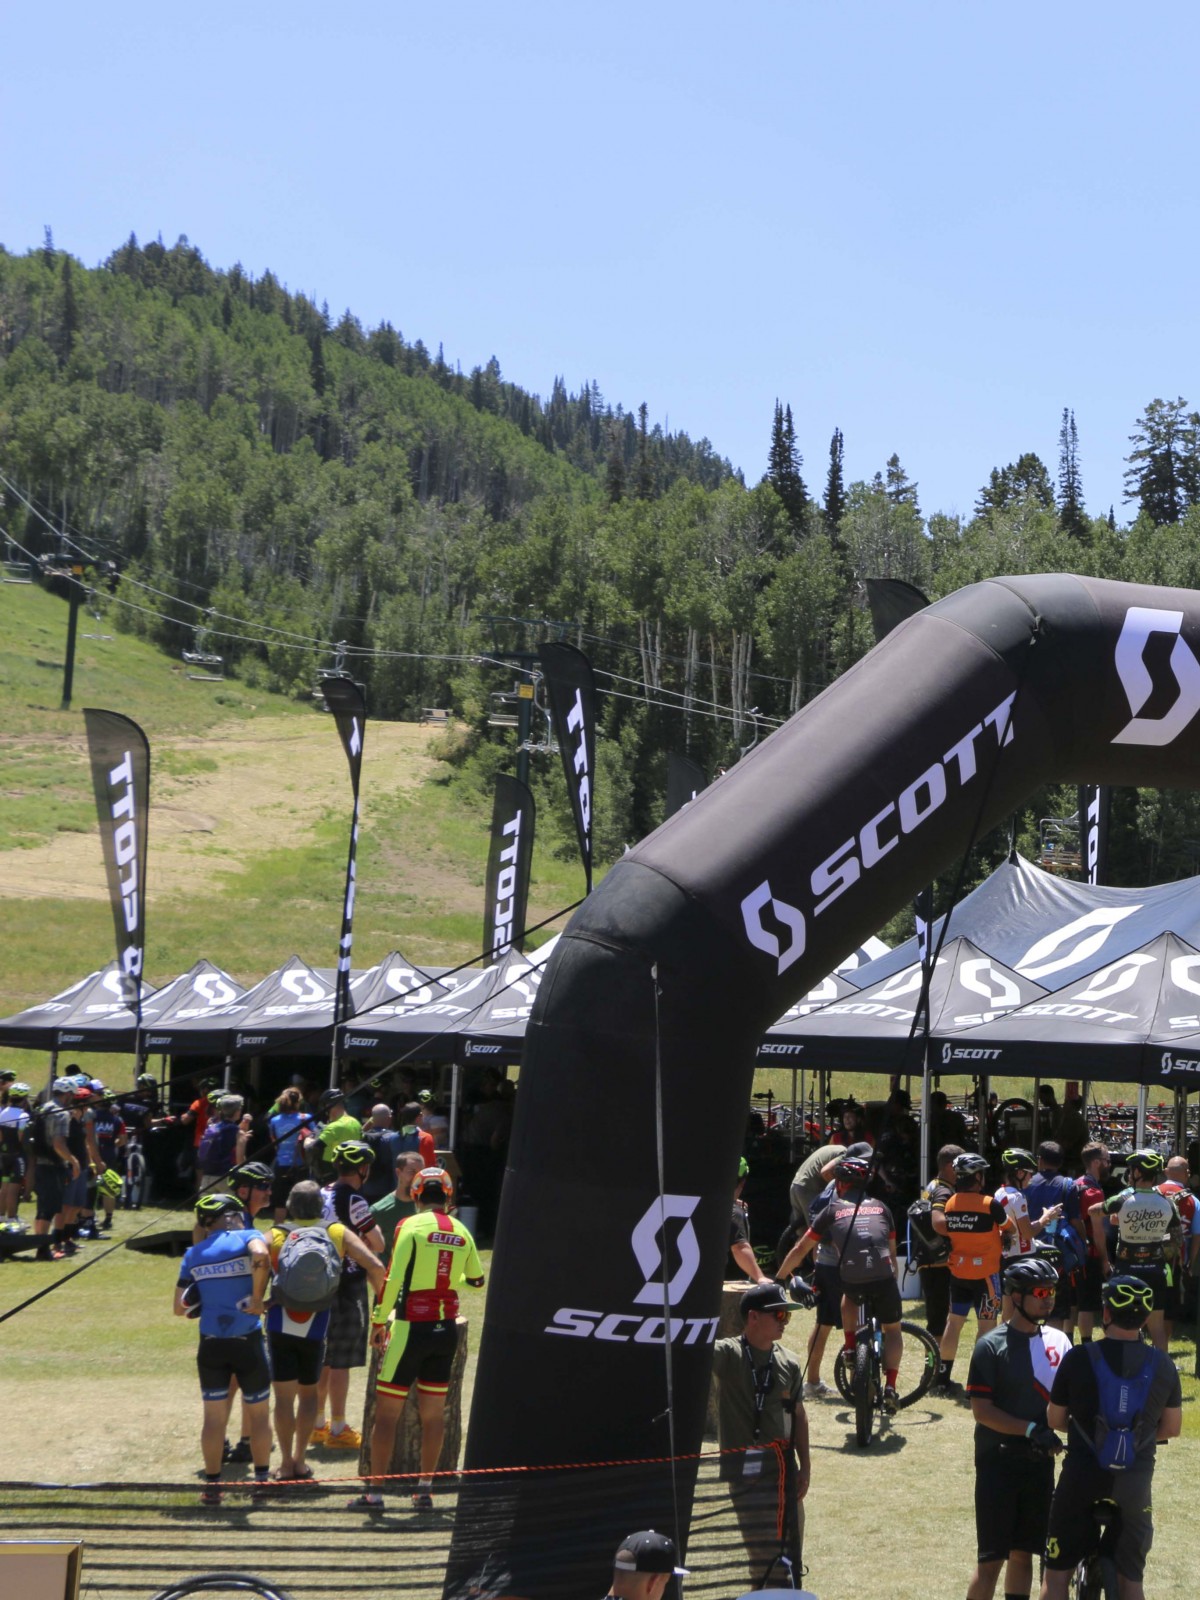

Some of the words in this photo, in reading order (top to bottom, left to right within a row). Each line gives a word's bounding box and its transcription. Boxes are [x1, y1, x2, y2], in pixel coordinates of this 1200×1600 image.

[811, 689, 1017, 917] SCOTT
[814, 1003, 918, 1021] SCOTT
[1011, 1003, 1140, 1023] SCOTT
[241, 1036, 268, 1045] SCOTT
[350, 1037, 379, 1046] SCOTT
[470, 1044, 502, 1053] SCOTT
[760, 1043, 804, 1054] SCOTT
[951, 1049, 1002, 1059] SCOTT
[1123, 1208, 1164, 1224] Bikes
[431, 1232, 462, 1246] ELITE
